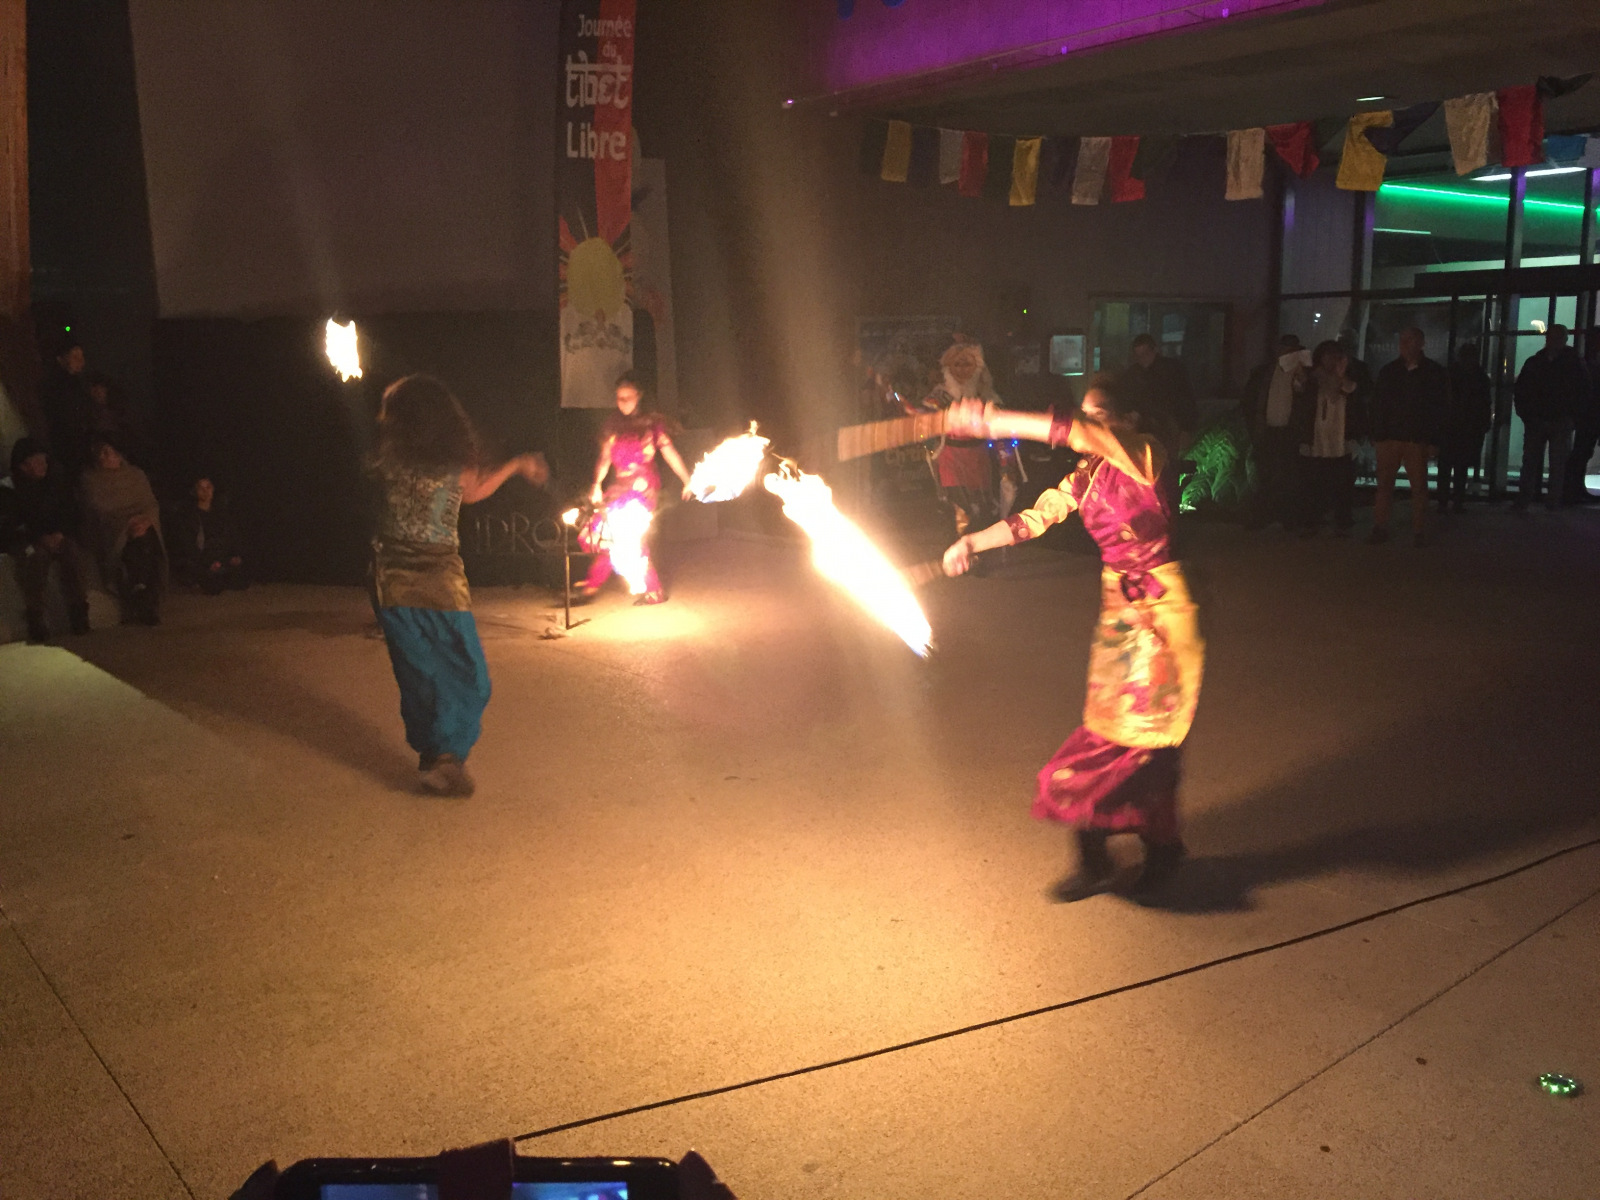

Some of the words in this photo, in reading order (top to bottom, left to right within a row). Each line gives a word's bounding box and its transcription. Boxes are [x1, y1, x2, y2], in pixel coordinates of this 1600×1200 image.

[578, 13, 632, 38] Journée
[602, 40, 617, 58] du
[566, 121, 627, 161] Libre
